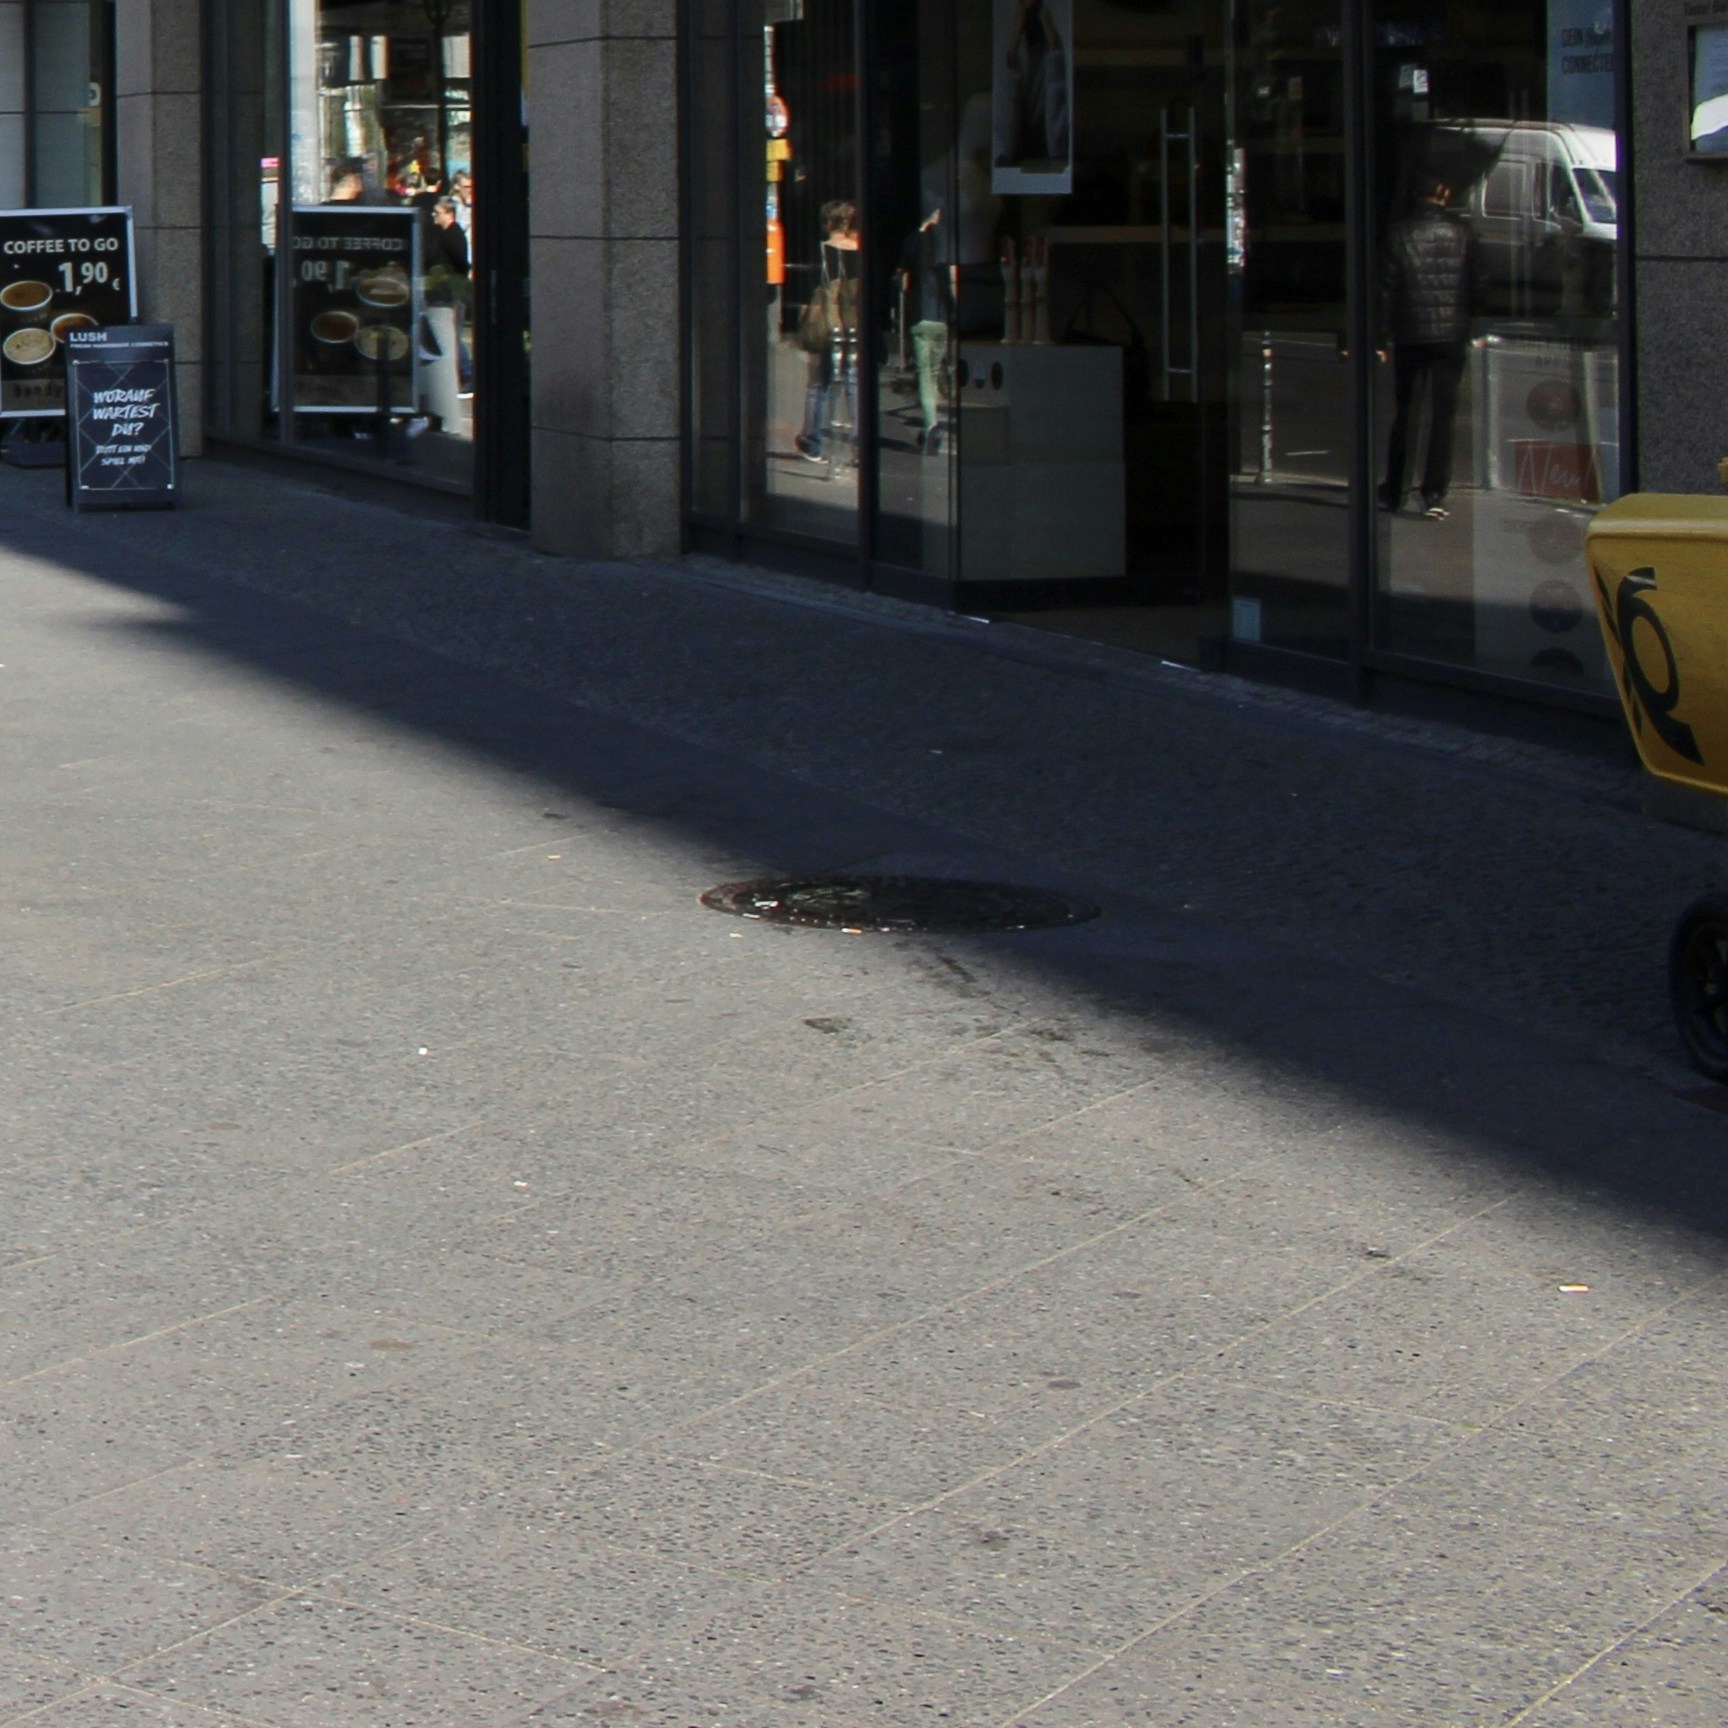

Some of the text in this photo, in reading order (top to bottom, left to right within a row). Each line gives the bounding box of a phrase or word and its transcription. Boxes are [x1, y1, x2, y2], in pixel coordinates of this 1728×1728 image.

[3, 237, 119, 255] COFFEE TO GO
[58, 262, 109, 296] 1,90
[70, 332, 108, 342] LUSH
[93, 403, 161, 420] WARTEST
